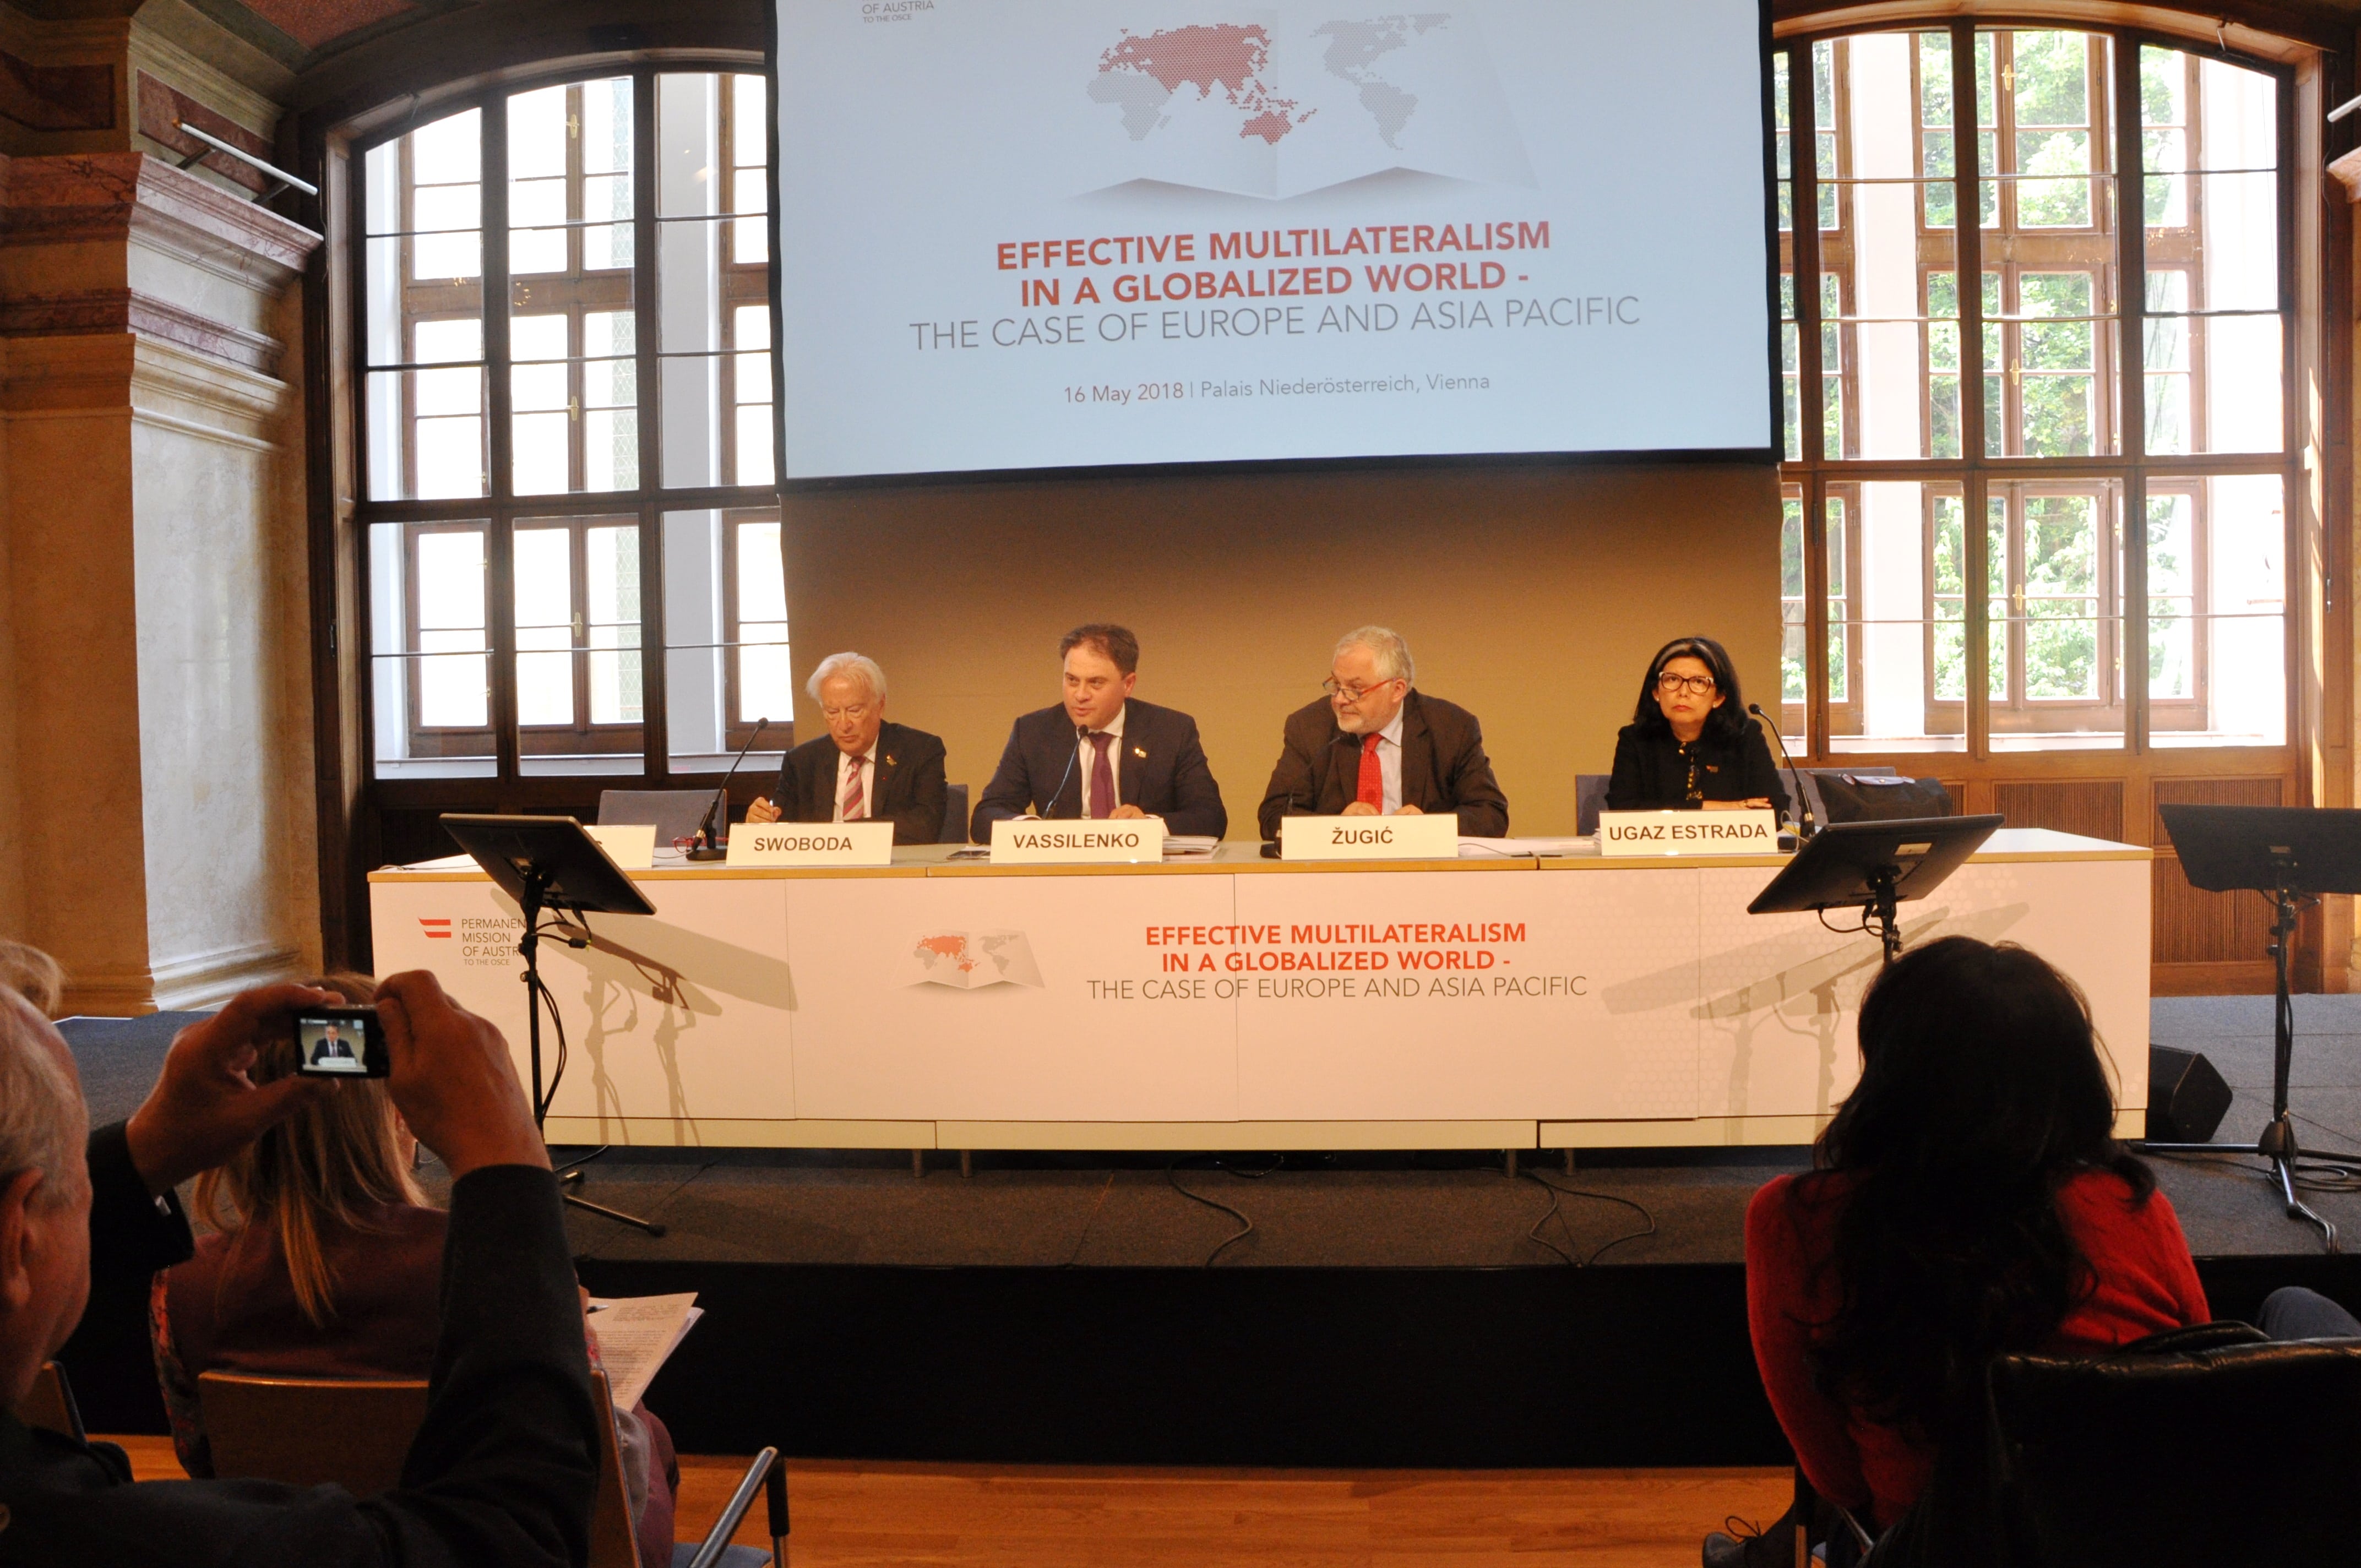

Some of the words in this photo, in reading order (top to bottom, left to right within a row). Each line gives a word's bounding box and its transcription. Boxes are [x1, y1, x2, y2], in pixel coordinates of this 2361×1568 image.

[862, 3, 879, 14] OF
[883, 0, 934, 13] AUSTRIA
[997, 234, 1195, 270] EFFECTIVE
[1209, 221, 1550, 260] MULTILATERALISM
[1021, 278, 1060, 307] IN
[1073, 277, 1101, 304] A
[1113, 266, 1352, 303] GLOBALIZED
[1364, 261, 1506, 293] WORLD
[909, 320, 979, 350] THE
[992, 315, 1085, 347] CASE
[1098, 313, 1149, 342] OF
[1162, 307, 1305, 339] EUROPE
[1316, 304, 1399, 333] AND
[1411, 300, 1494, 330] ASIA
[1506, 296, 1640, 327] PACIFIC
[1064, 386, 1086, 403] 16
[1092, 385, 1131, 406] May
[1138, 382, 1184, 400] 2018
[1201, 380, 1253, 398] Palais
[1260, 374, 1420, 396] Niederösterreich,
[1426, 374, 1490, 390] Vienna
[1013, 833, 1140, 848] VASSILENKO
[1331, 825, 1394, 845] ŽUGIĆ
[1609, 825, 1665, 841] UGAZ
[1672, 824, 1768, 839] ESTRADA
[754, 837, 852, 852] SWOBODA
[461, 918, 526, 929] PERMANEN
[463, 932, 510, 943] MISSION
[1146, 925, 1281, 945] EFFECTIVE
[1291, 923, 1525, 944] MULTILATERALISM
[463, 946, 479, 956] OF
[482, 946, 520, 956] AUSTR
[1163, 953, 1188, 972] IN
[1198, 952, 1217, 971] A
[1225, 951, 1389, 971] GLOBALIZED
[1397, 950, 1495, 970] WORLD
[1086, 980, 1134, 999] THE
[1142, 979, 1206, 999] CASE
[1215, 979, 1249, 998] OF
[1258, 978, 1356, 998] EUROPE
[1363, 977, 1420, 997] AND
[1428, 977, 1485, 997] ASIA
[1494, 976, 1587, 997] PACIFIC
